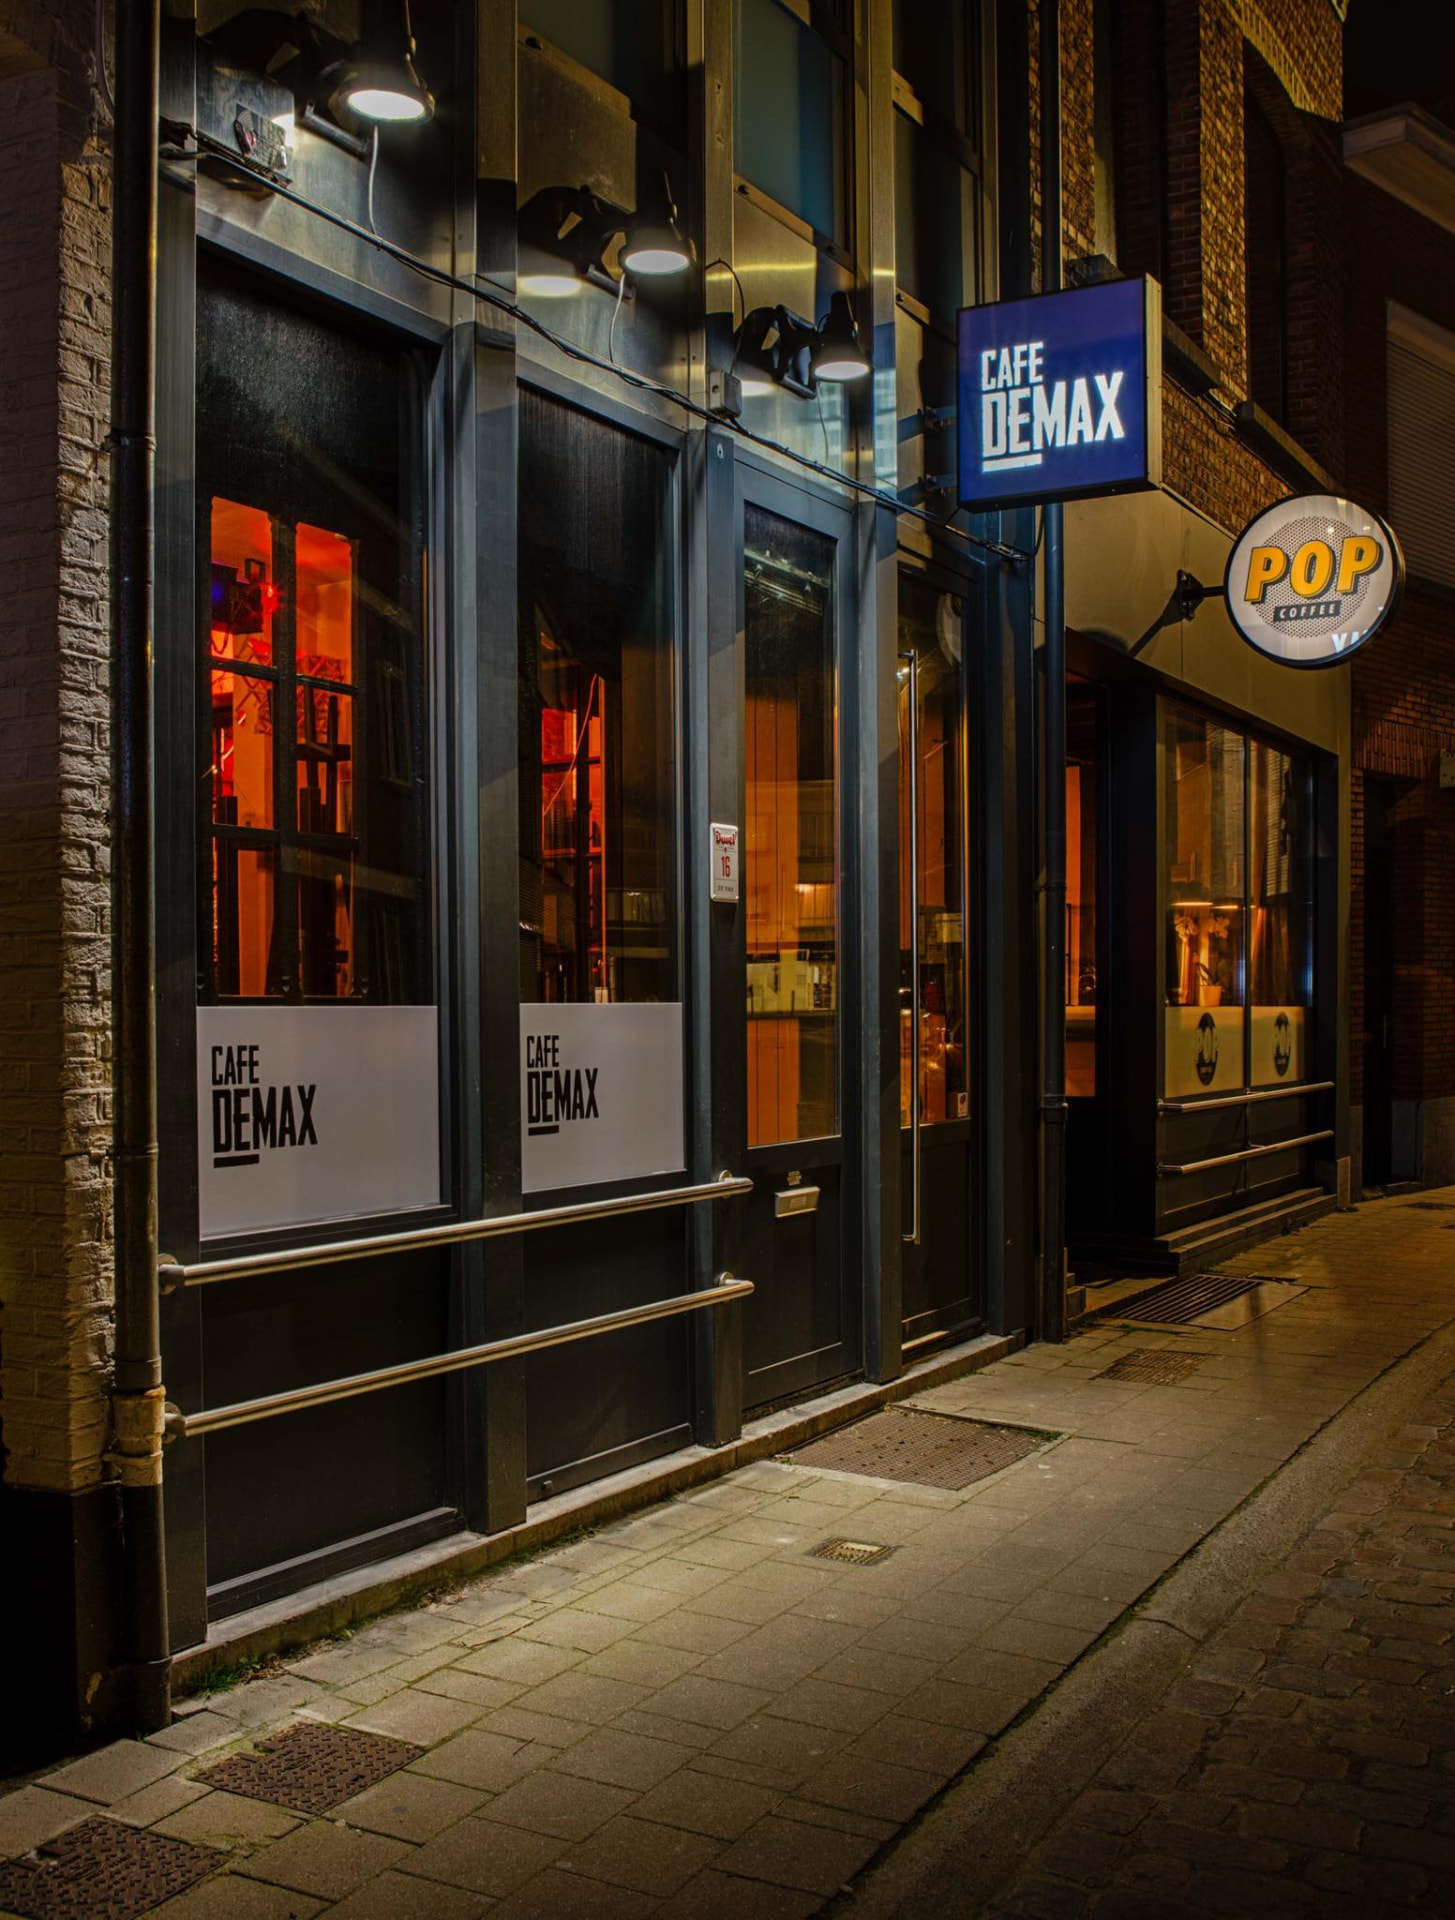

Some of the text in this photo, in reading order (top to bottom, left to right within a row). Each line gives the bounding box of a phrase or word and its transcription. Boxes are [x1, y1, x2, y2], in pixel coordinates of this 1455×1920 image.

[981, 341, 1044, 392] CAFE
[981, 371, 1125, 458] DEMAX
[1244, 535, 1384, 604] POP
[1279, 603, 1336, 619] COFFEE
[721, 856, 731, 877] 16
[211, 1045, 260, 1086] CAFE
[527, 1035, 560, 1068] CAFE
[212, 1084, 318, 1153] DEMAX
[527, 1068, 599, 1124] DEMAX
